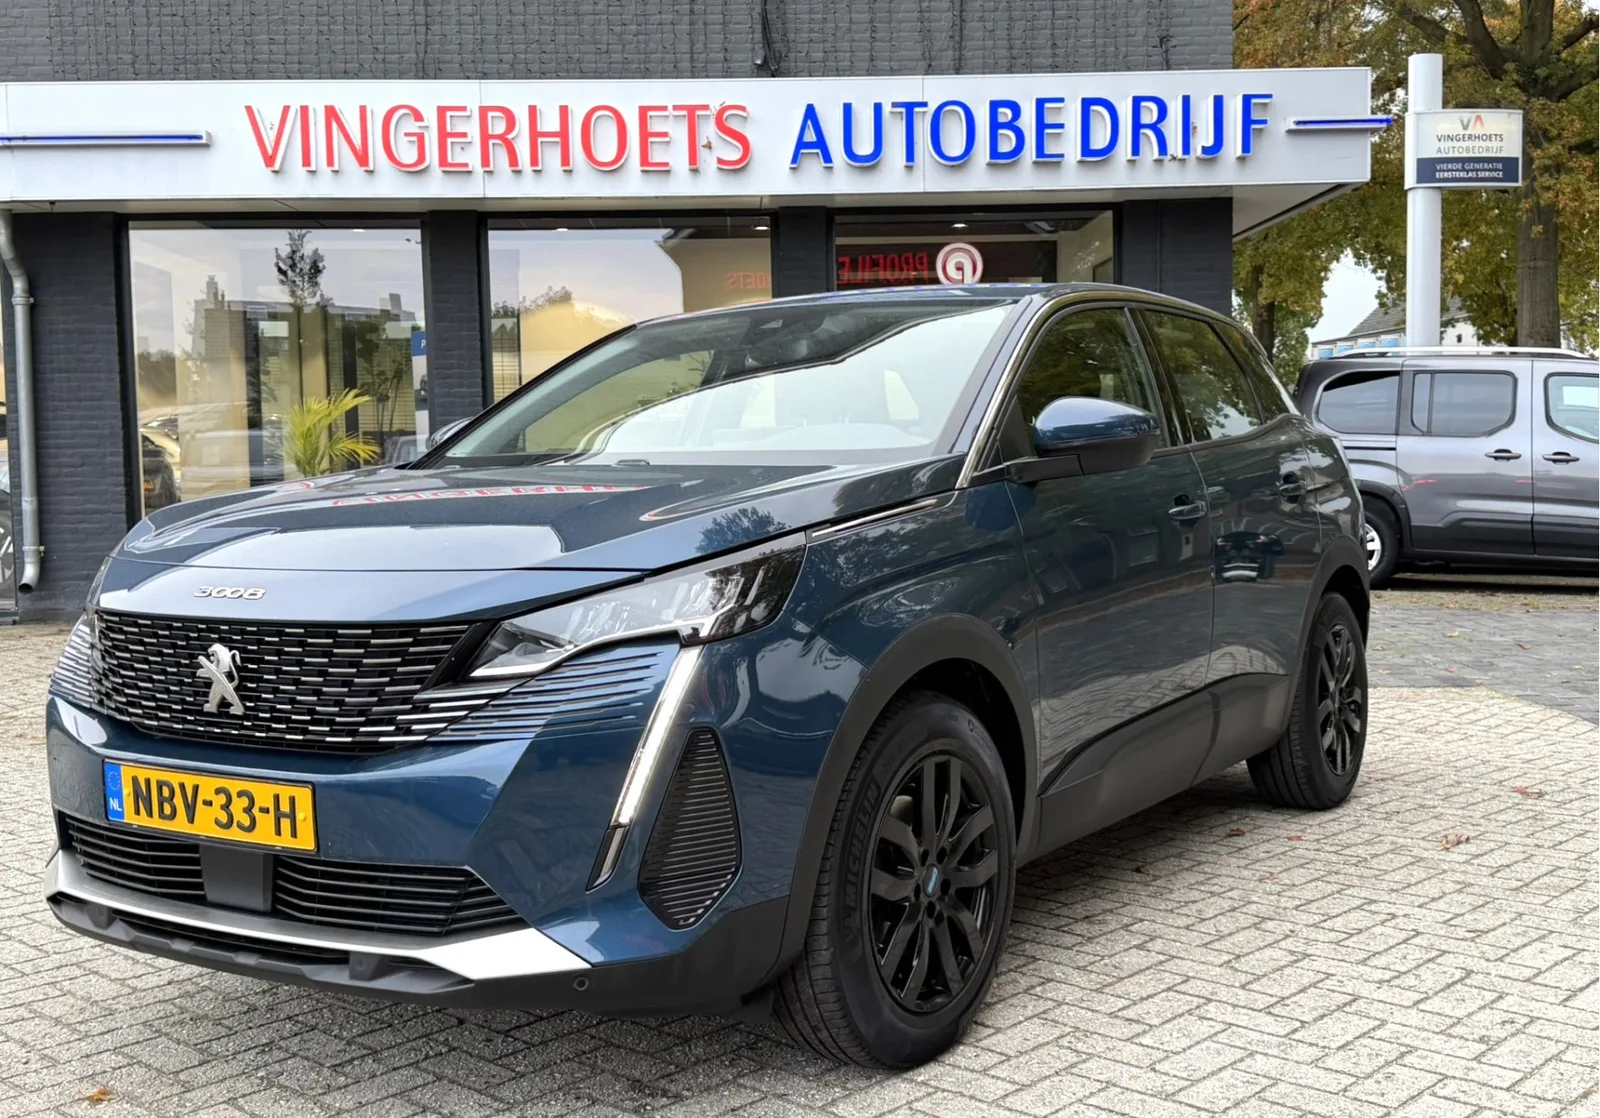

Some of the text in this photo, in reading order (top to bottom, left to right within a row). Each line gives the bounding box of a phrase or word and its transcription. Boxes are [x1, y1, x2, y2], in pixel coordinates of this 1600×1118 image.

[245, 93, 1274, 171] VINGERHOETS AUTOBEDRIJF
[1436, 133, 1504, 143] VINGERHOETS
[1436, 146, 1504, 155] AUTOBEDRIJF
[1435, 162, 1503, 170] VIERDE GENERATIE
[1435, 171, 1504, 179] EERSTEKLAS SERVICE
[193, 586, 267, 601] 3008
[109, 796, 123, 813] NL
[130, 774, 299, 839] NBV-33-H
[846, 779, 881, 908] MICHELIN
